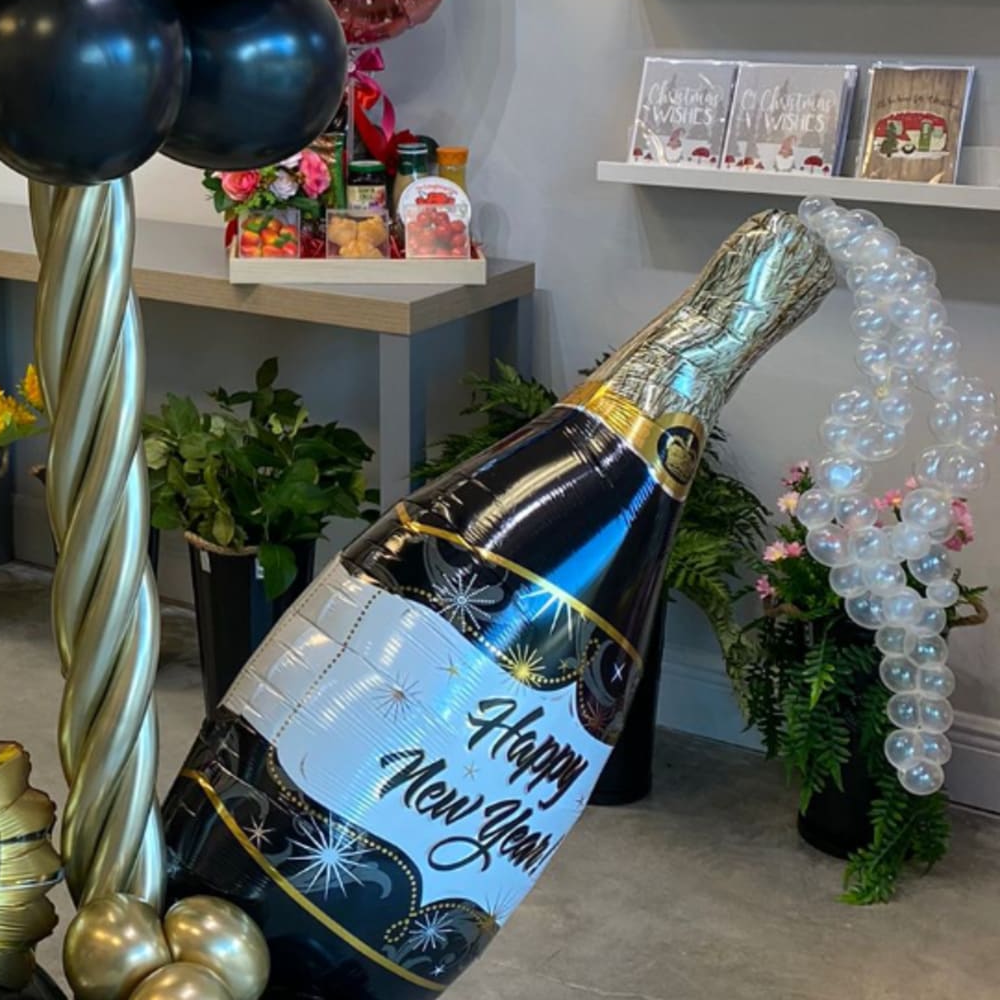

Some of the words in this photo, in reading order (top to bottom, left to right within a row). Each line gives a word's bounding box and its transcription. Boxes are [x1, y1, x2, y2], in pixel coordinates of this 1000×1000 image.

[652, 105, 714, 127] WISHES
[763, 111, 826, 134] WISHES
[467, 698, 589, 810] Happy
[379, 748, 484, 826] New
